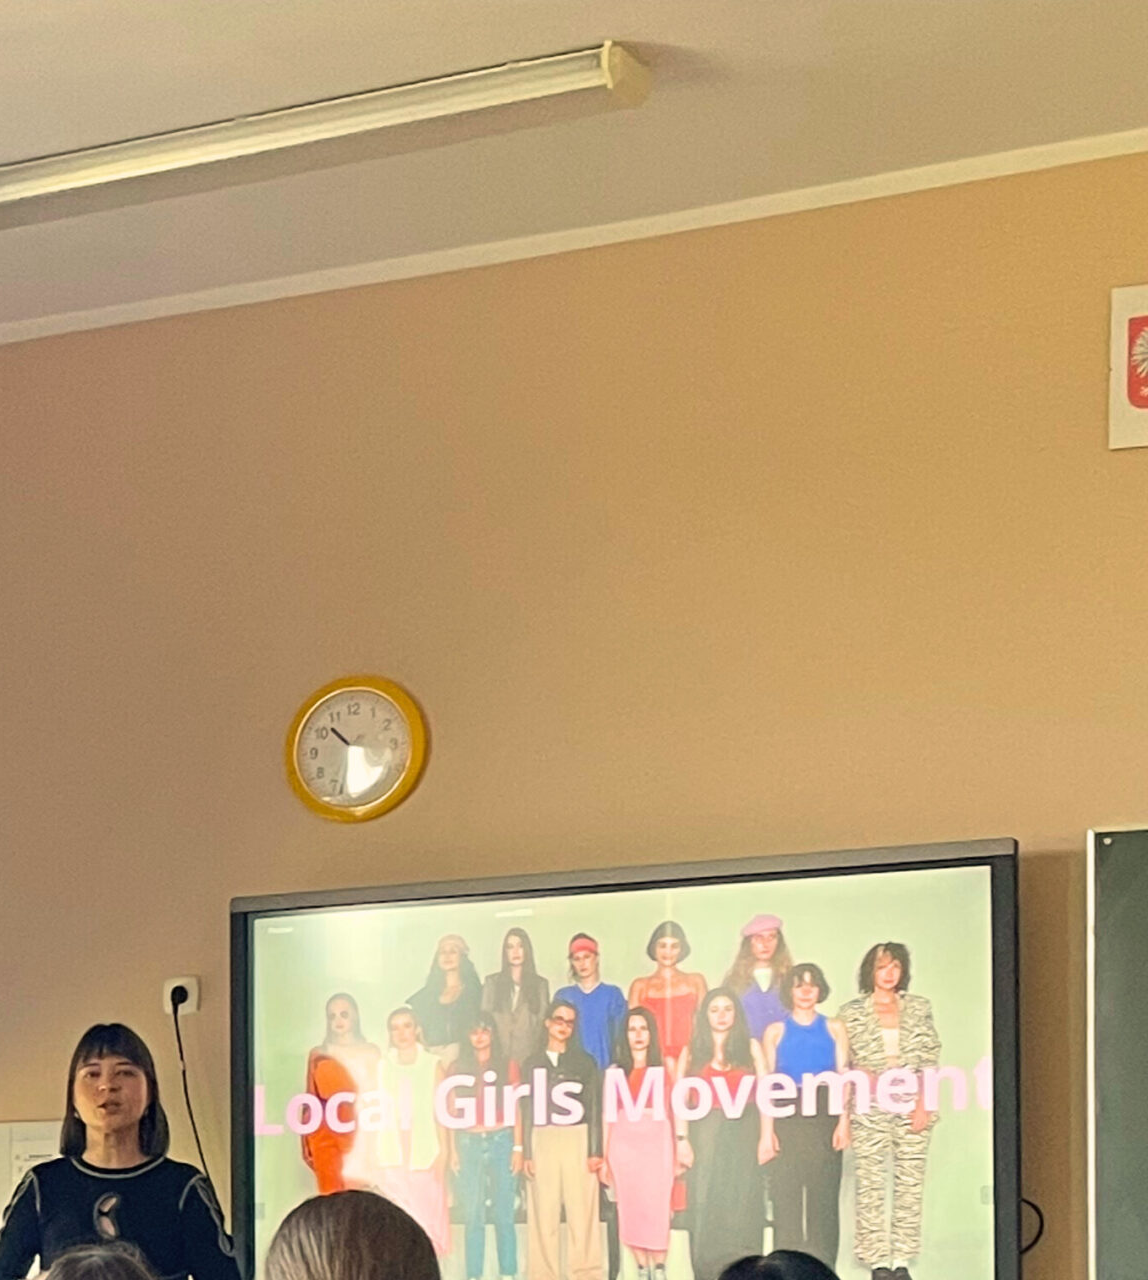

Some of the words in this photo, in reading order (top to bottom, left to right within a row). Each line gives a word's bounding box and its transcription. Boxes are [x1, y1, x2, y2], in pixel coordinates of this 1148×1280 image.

[347, 702, 361, 716] 12
[369, 706, 376, 718] 1
[329, 711, 341, 723] 11
[383, 718, 393, 731] 2
[314, 726, 329, 740] 10
[389, 738, 398, 750] 3
[309, 747, 319, 760] 9
[316, 766, 325, 779] 8
[330, 779, 339, 792] 7
[253, 1078, 414, 1137] Local
[434, 1067, 585, 1129] Girls
